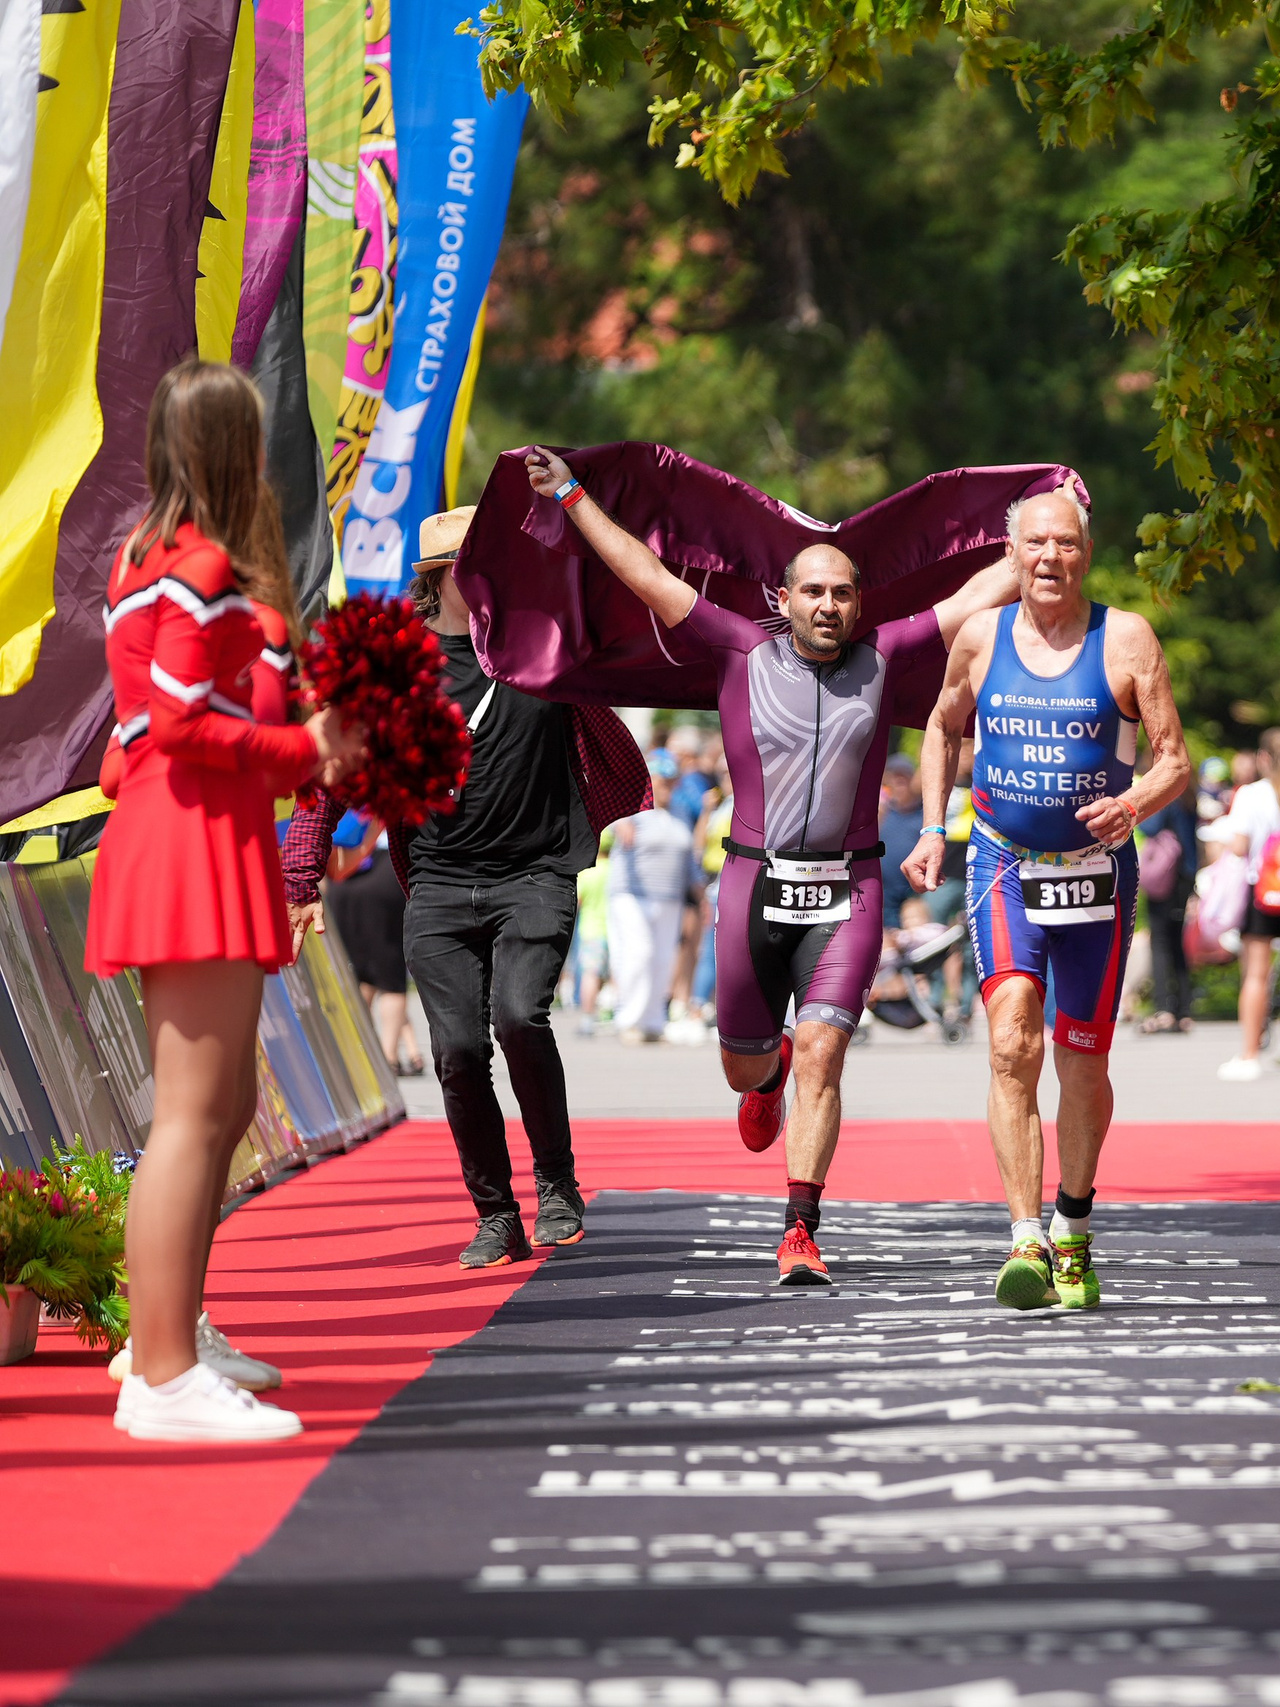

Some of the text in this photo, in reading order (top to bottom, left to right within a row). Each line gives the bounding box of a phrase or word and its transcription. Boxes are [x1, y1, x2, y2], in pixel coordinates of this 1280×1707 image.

[415, 117, 477, 393] СТРАХОВОЙ ДОМ
[342, 398, 431, 581] ВСК
[1004, 694, 1098, 708] GLOBAL FINANCE
[986, 716, 1101, 739] KIRILLOV
[1022, 744, 1066, 764] RUS
[987, 764, 1108, 792] MASTERS
[990, 787, 1065, 807] TRIATHLON
[780, 884, 832, 908] 3139
[1040, 880, 1096, 908] 3119
[968, 916, 985, 983] FINANCE
